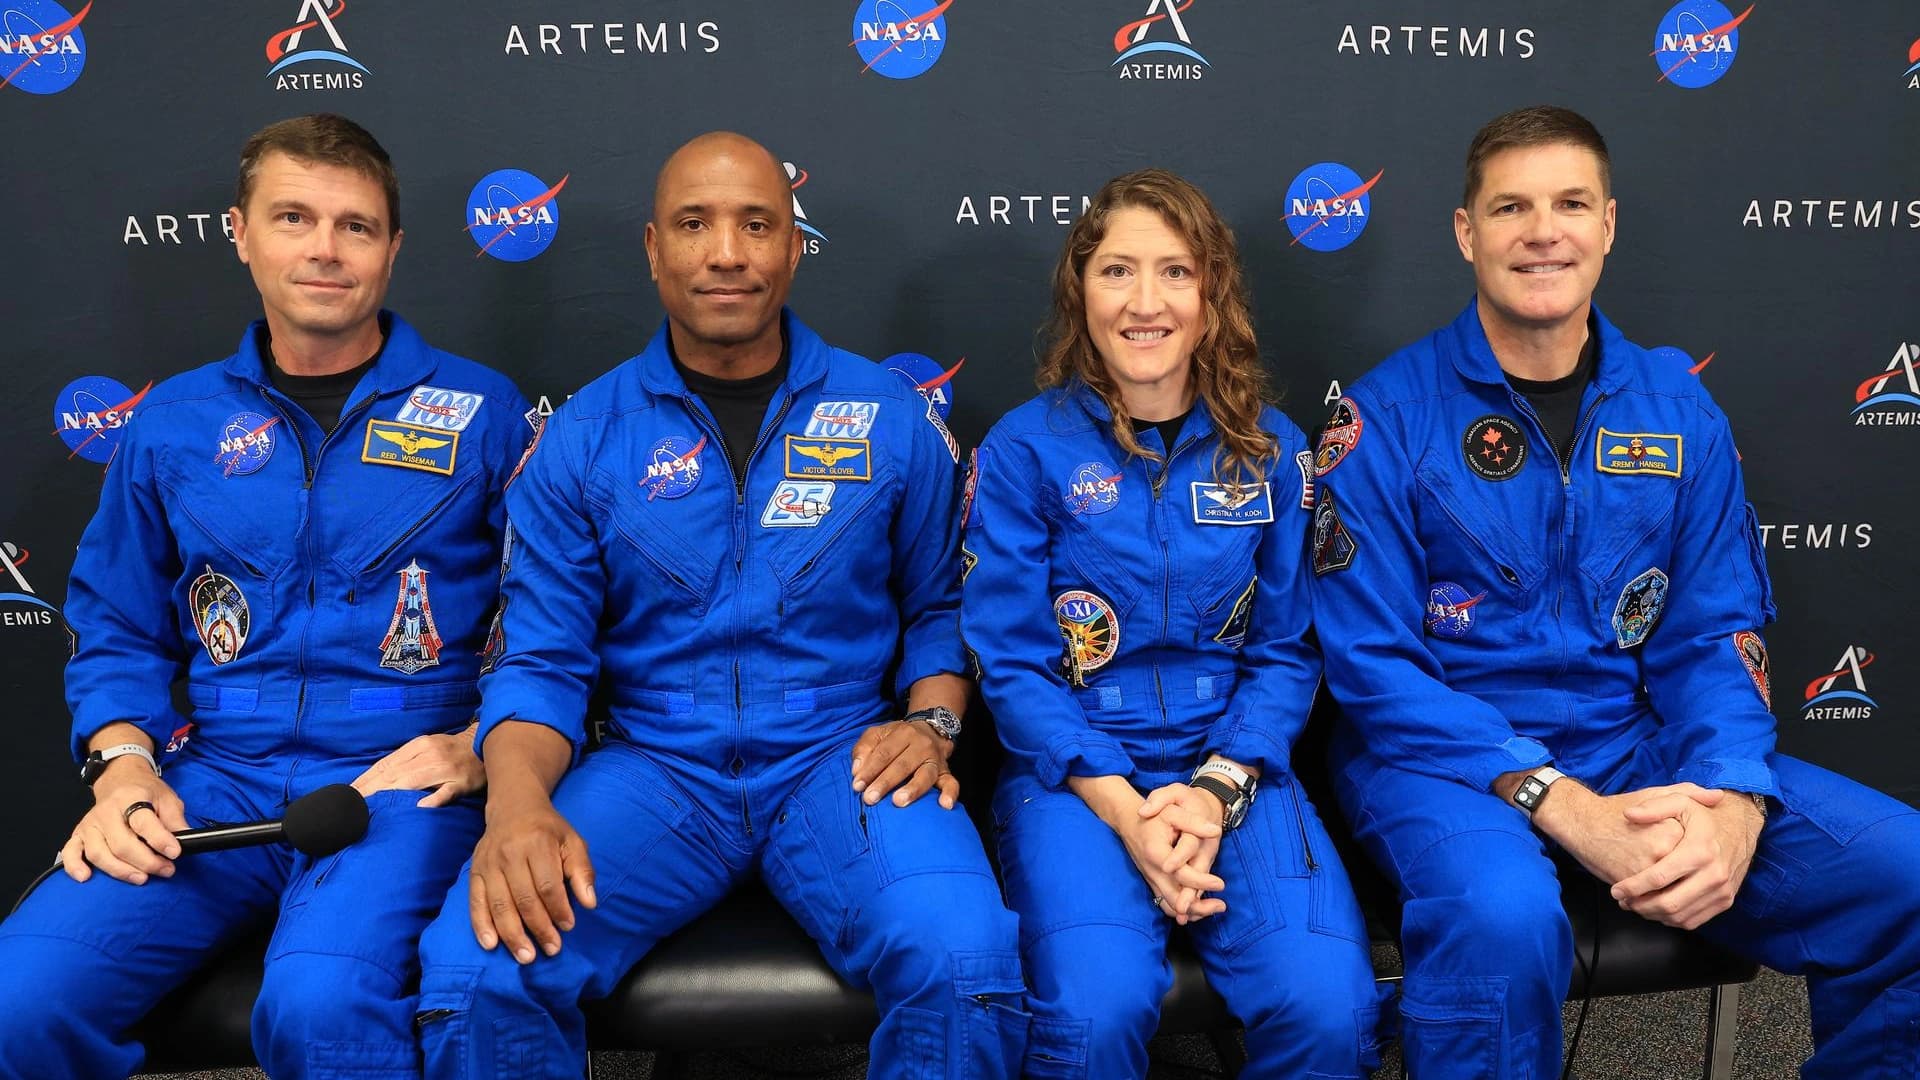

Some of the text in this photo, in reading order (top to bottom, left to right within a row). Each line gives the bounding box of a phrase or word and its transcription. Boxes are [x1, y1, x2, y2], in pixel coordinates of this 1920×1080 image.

[505, 21, 720, 55] ARTEMIS
[861, 22, 941, 42] NASA
[1338, 25, 1535, 59] ARTEMIS
[1661, 33, 1733, 53] NASA
[276, 73, 363, 91] ARTEMIS
[1119, 64, 1203, 81] ARTEMIS
[474, 206, 553, 227] NASA
[1291, 198, 1365, 218] NASA
[1742, 200, 1920, 228] ARTEMIS
[1467, 422, 1483, 444] CANADIAN
[1500, 419, 1519, 434] AGENCY
[220, 431, 270, 454] NASA
[380, 451, 436, 467] REID WISEMAN
[647, 457, 700, 478] NASA
[1611, 460, 1667, 470] JEREMY HANSEN
[803, 466, 855, 475] VICTOR GLOVER
[1072, 481, 1118, 497] NASA
[1205, 509, 1232, 518] CHRISTINA
[1244, 509, 1263, 517] KOCH
[0, 611, 52, 626] EMIS
[1063, 602, 1091, 618] LXI
[213, 634, 232, 654] XL
[1804, 708, 1871, 720] ARTEMIS
